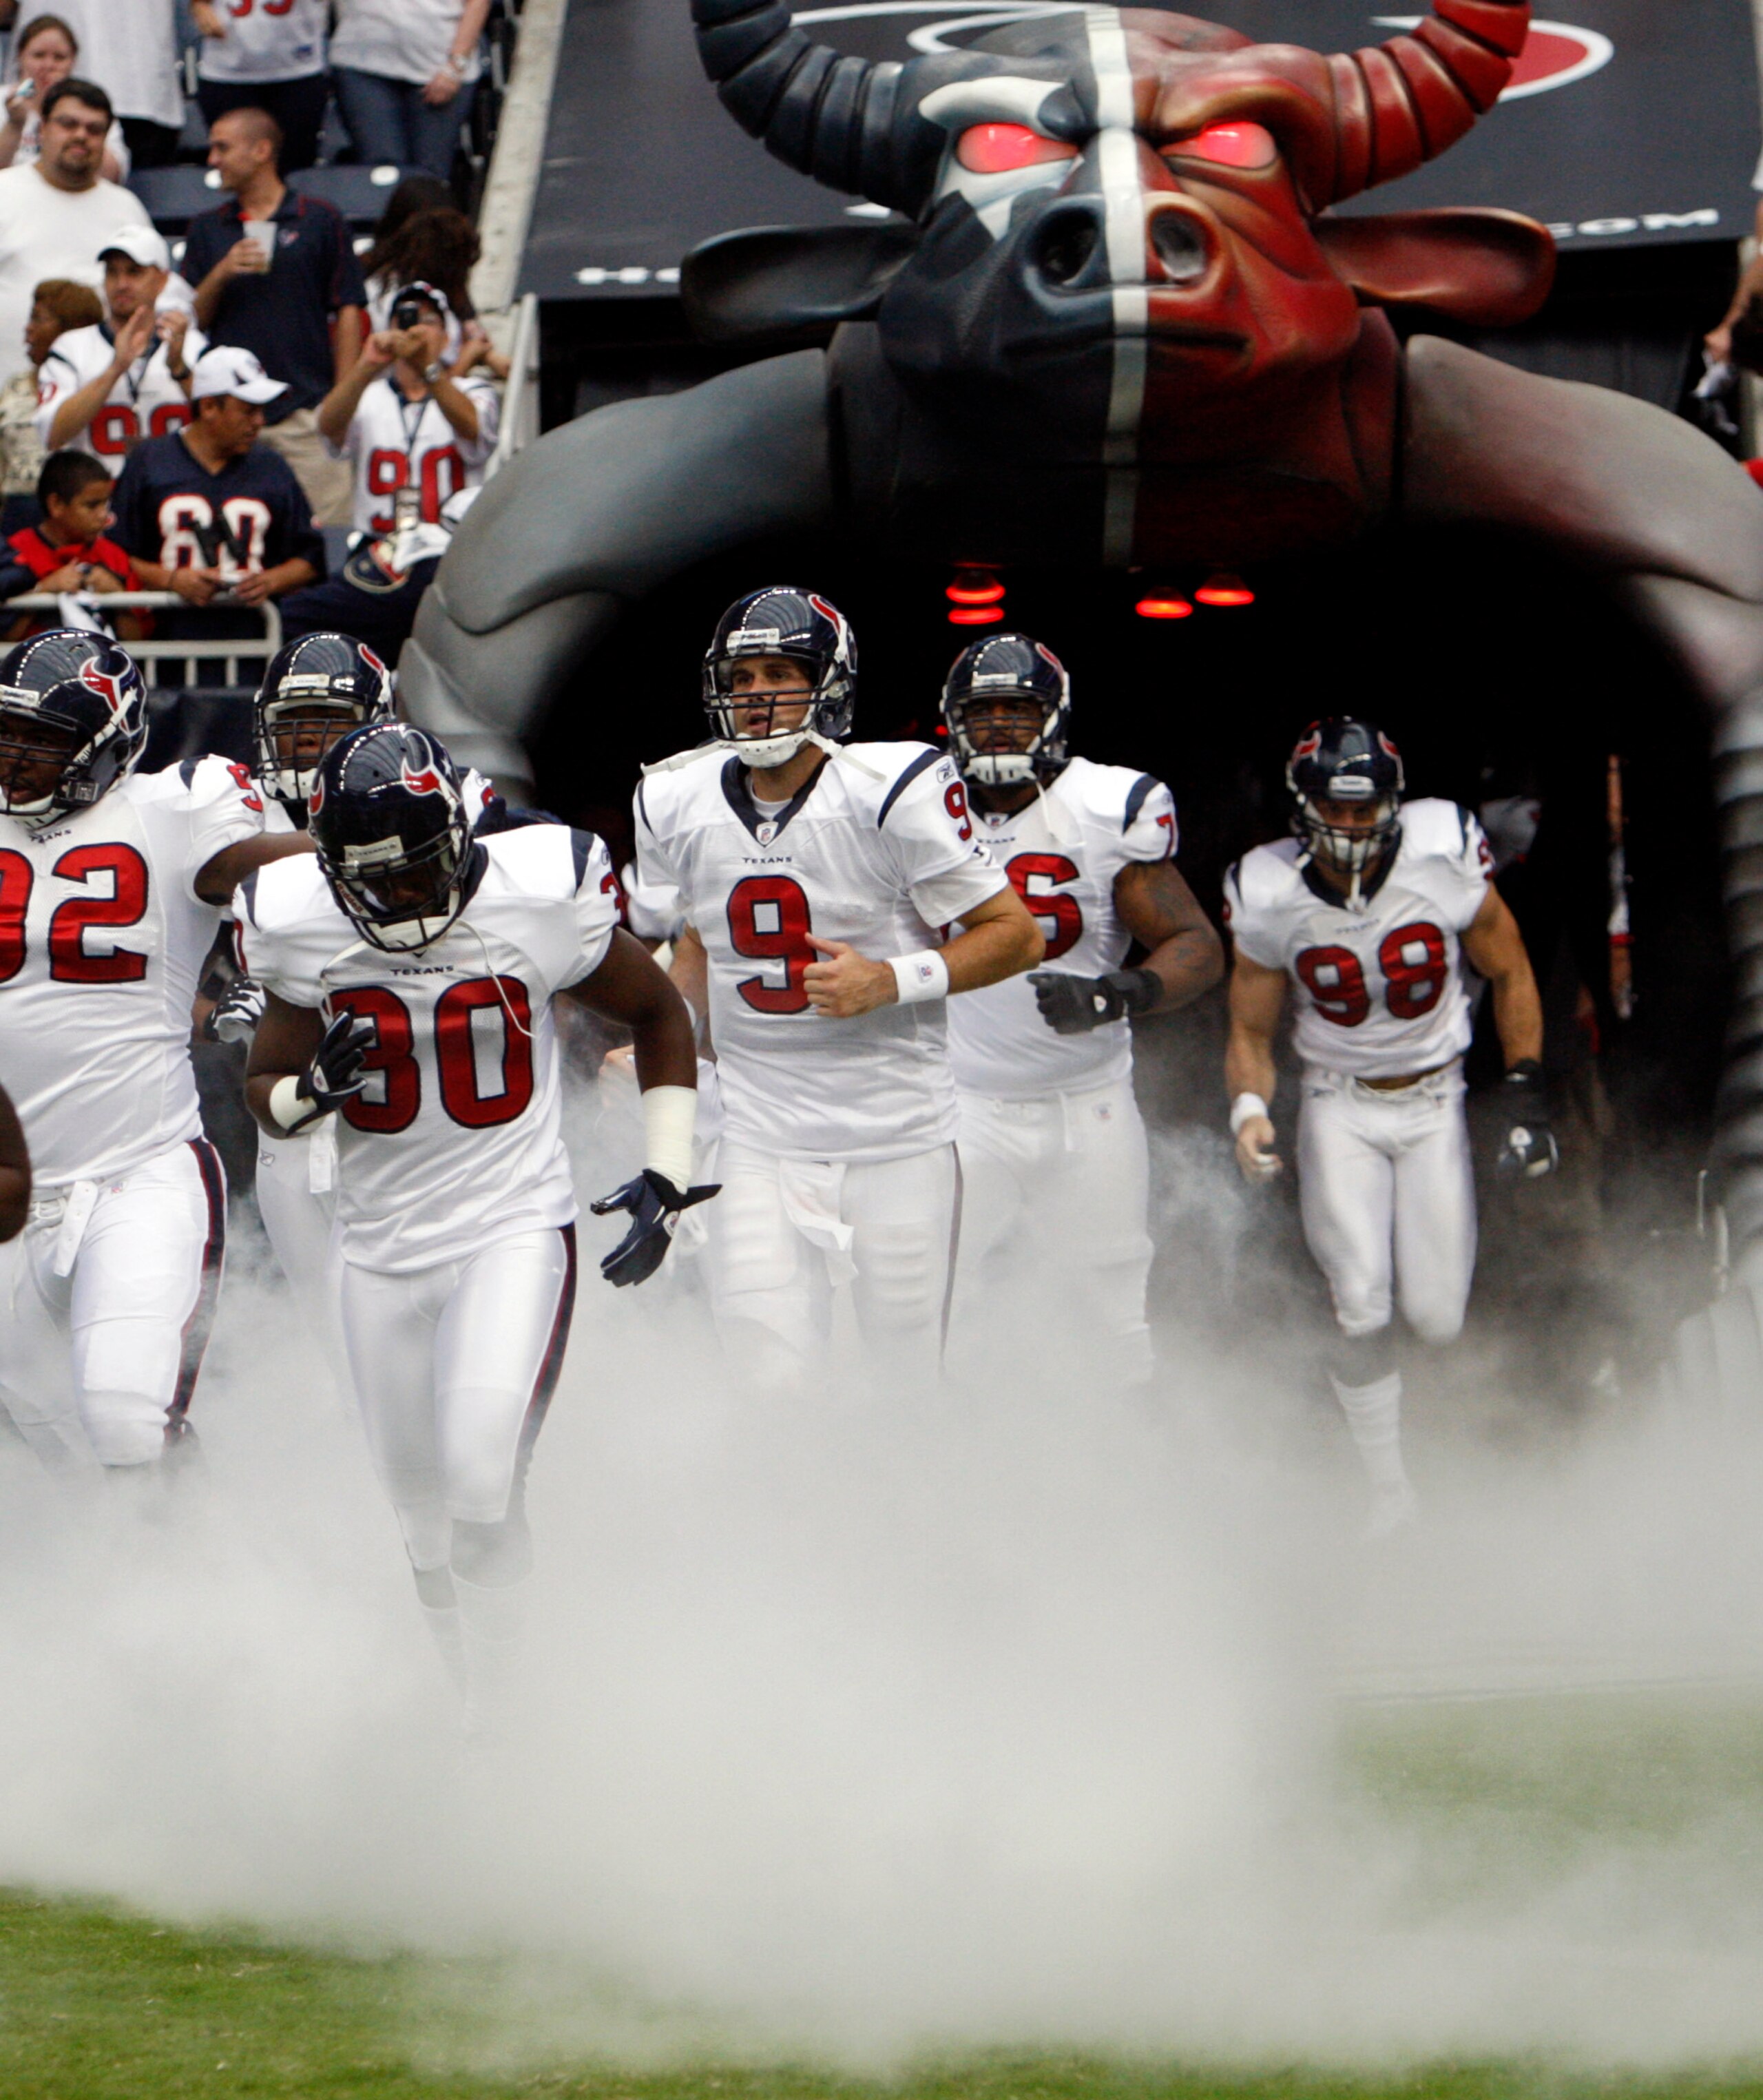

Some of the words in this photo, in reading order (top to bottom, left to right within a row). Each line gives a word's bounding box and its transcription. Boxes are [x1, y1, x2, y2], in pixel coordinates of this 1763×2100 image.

[742, 856, 792, 864] TEXANS
[944, 781, 972, 842] 9
[727, 874, 817, 1015] 9
[1005, 851, 1083, 962] 6
[390, 966, 454, 977] TEXANS
[1295, 921, 1448, 1027] 98
[322, 975, 534, 1134] 30
